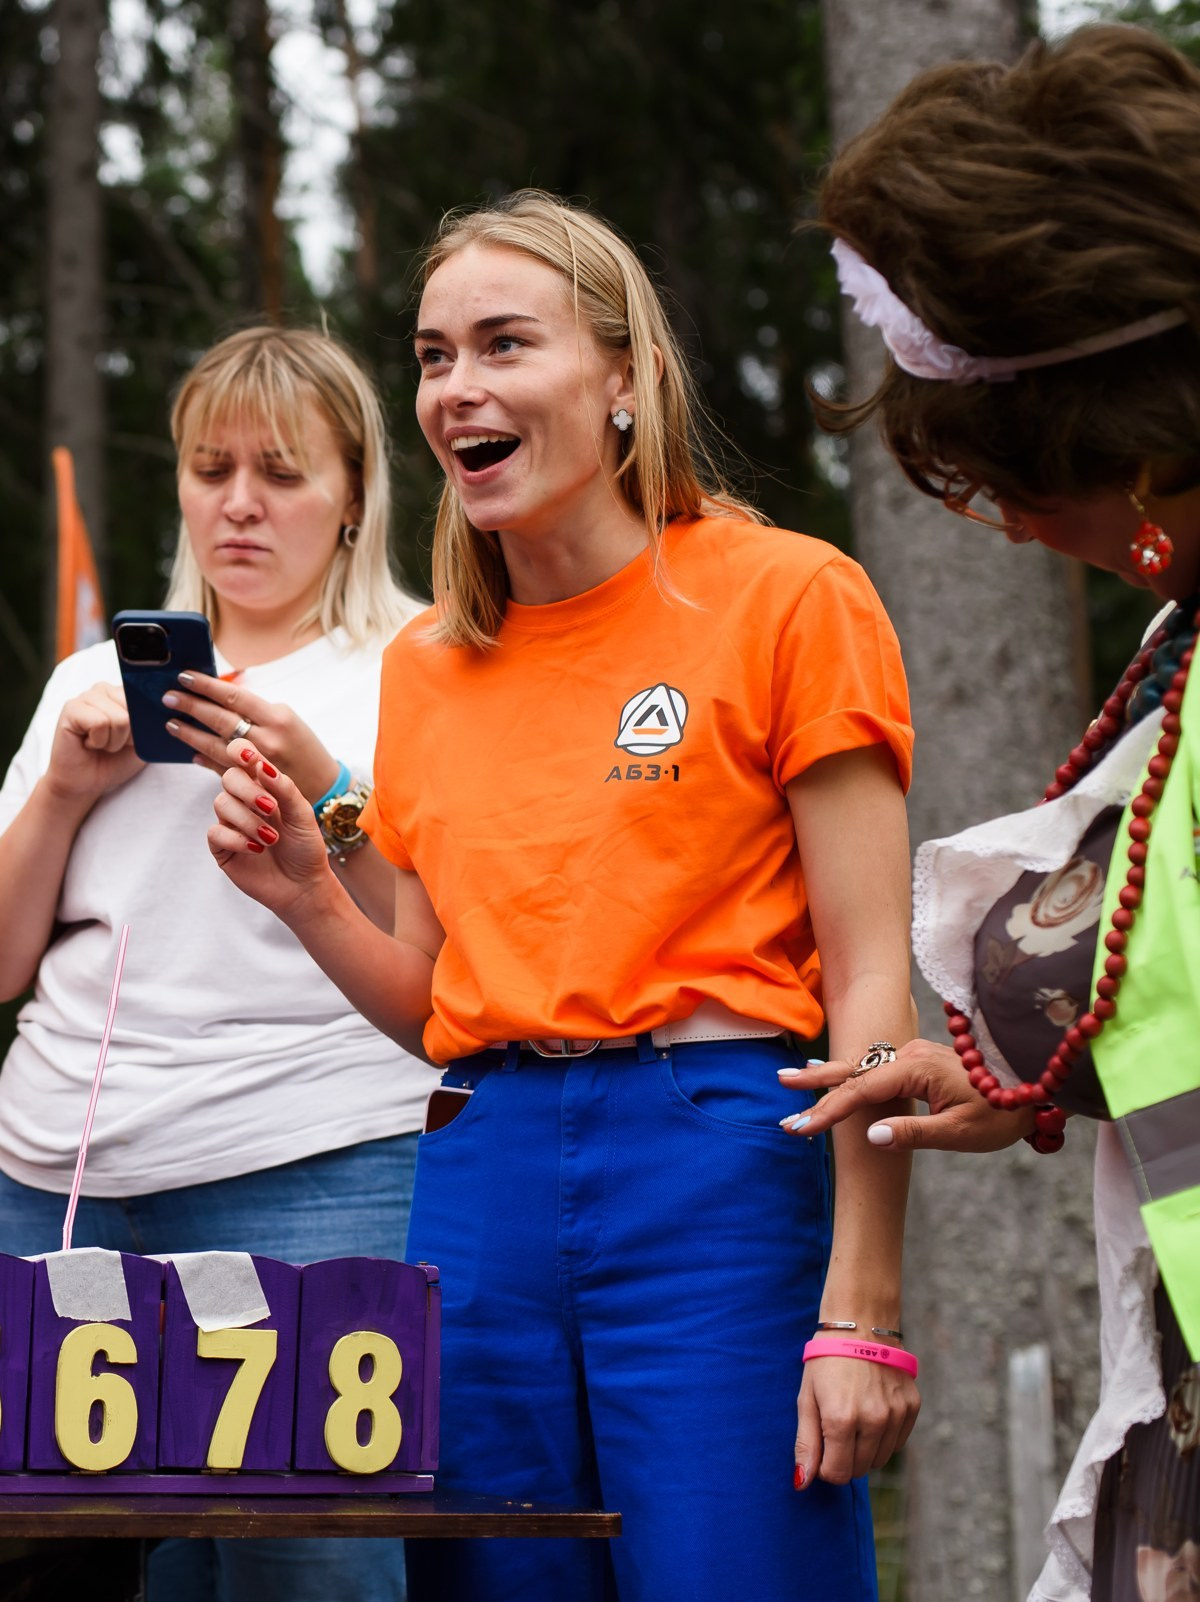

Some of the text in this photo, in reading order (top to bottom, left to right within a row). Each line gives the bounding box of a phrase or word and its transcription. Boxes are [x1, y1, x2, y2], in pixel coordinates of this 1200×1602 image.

[54, 1322, 138, 1471] 6
[196, 1328, 278, 1469] 7
[324, 1330, 403, 1474] 8
